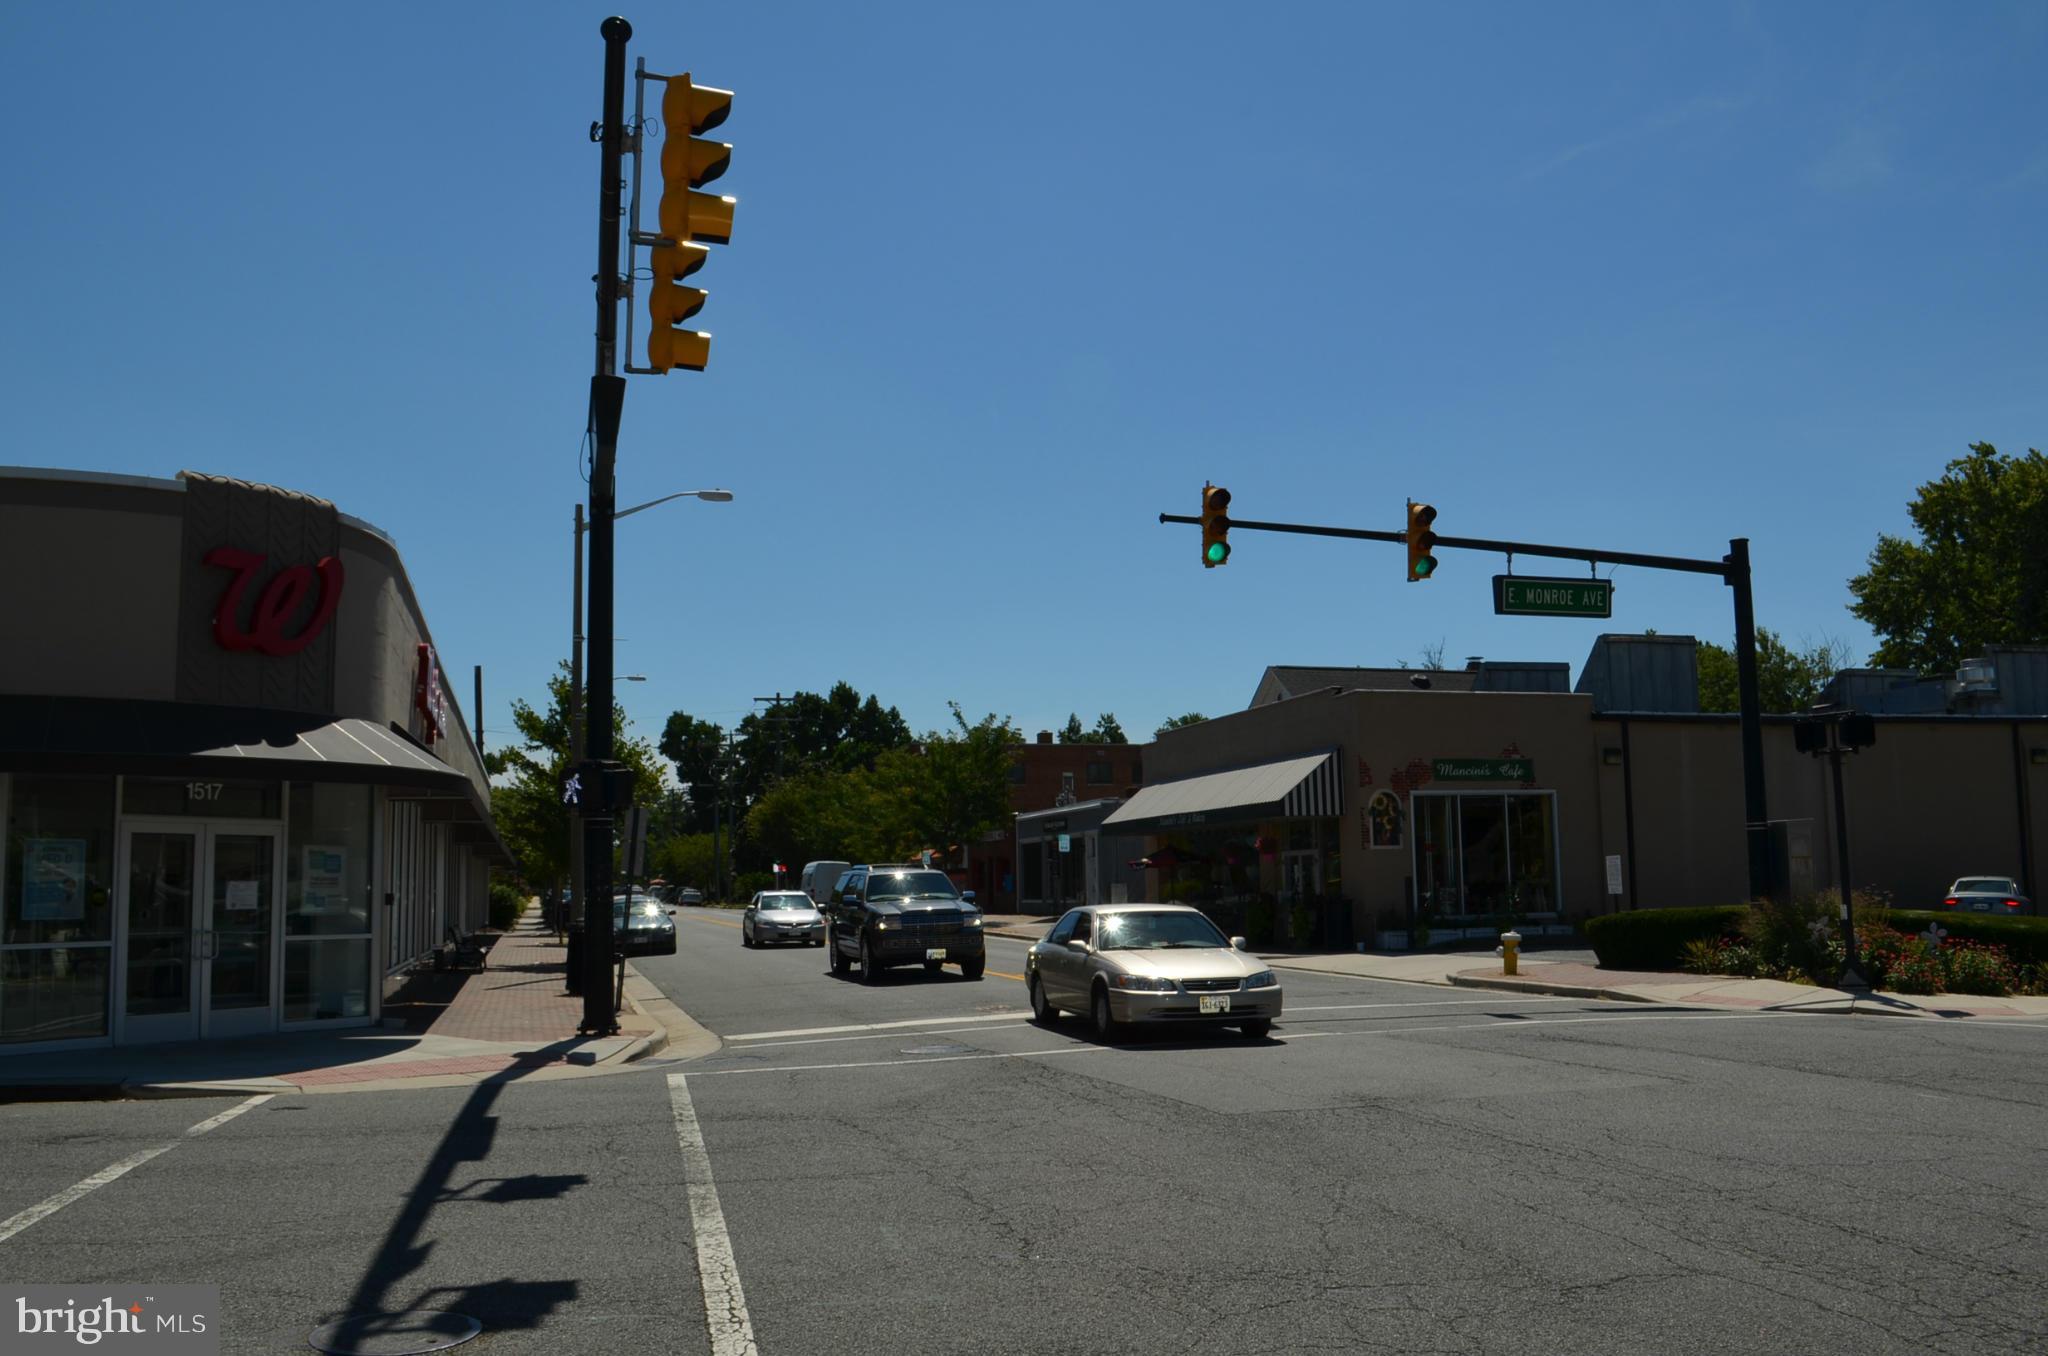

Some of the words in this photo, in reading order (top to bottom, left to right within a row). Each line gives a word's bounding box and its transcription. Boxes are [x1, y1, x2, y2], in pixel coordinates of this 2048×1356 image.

[1526, 588, 1574, 606] MONROE
[1582, 589, 1604, 607] AVE
[1499, 763, 1525, 779] Cafe
[185, 782, 224, 800] 1517
